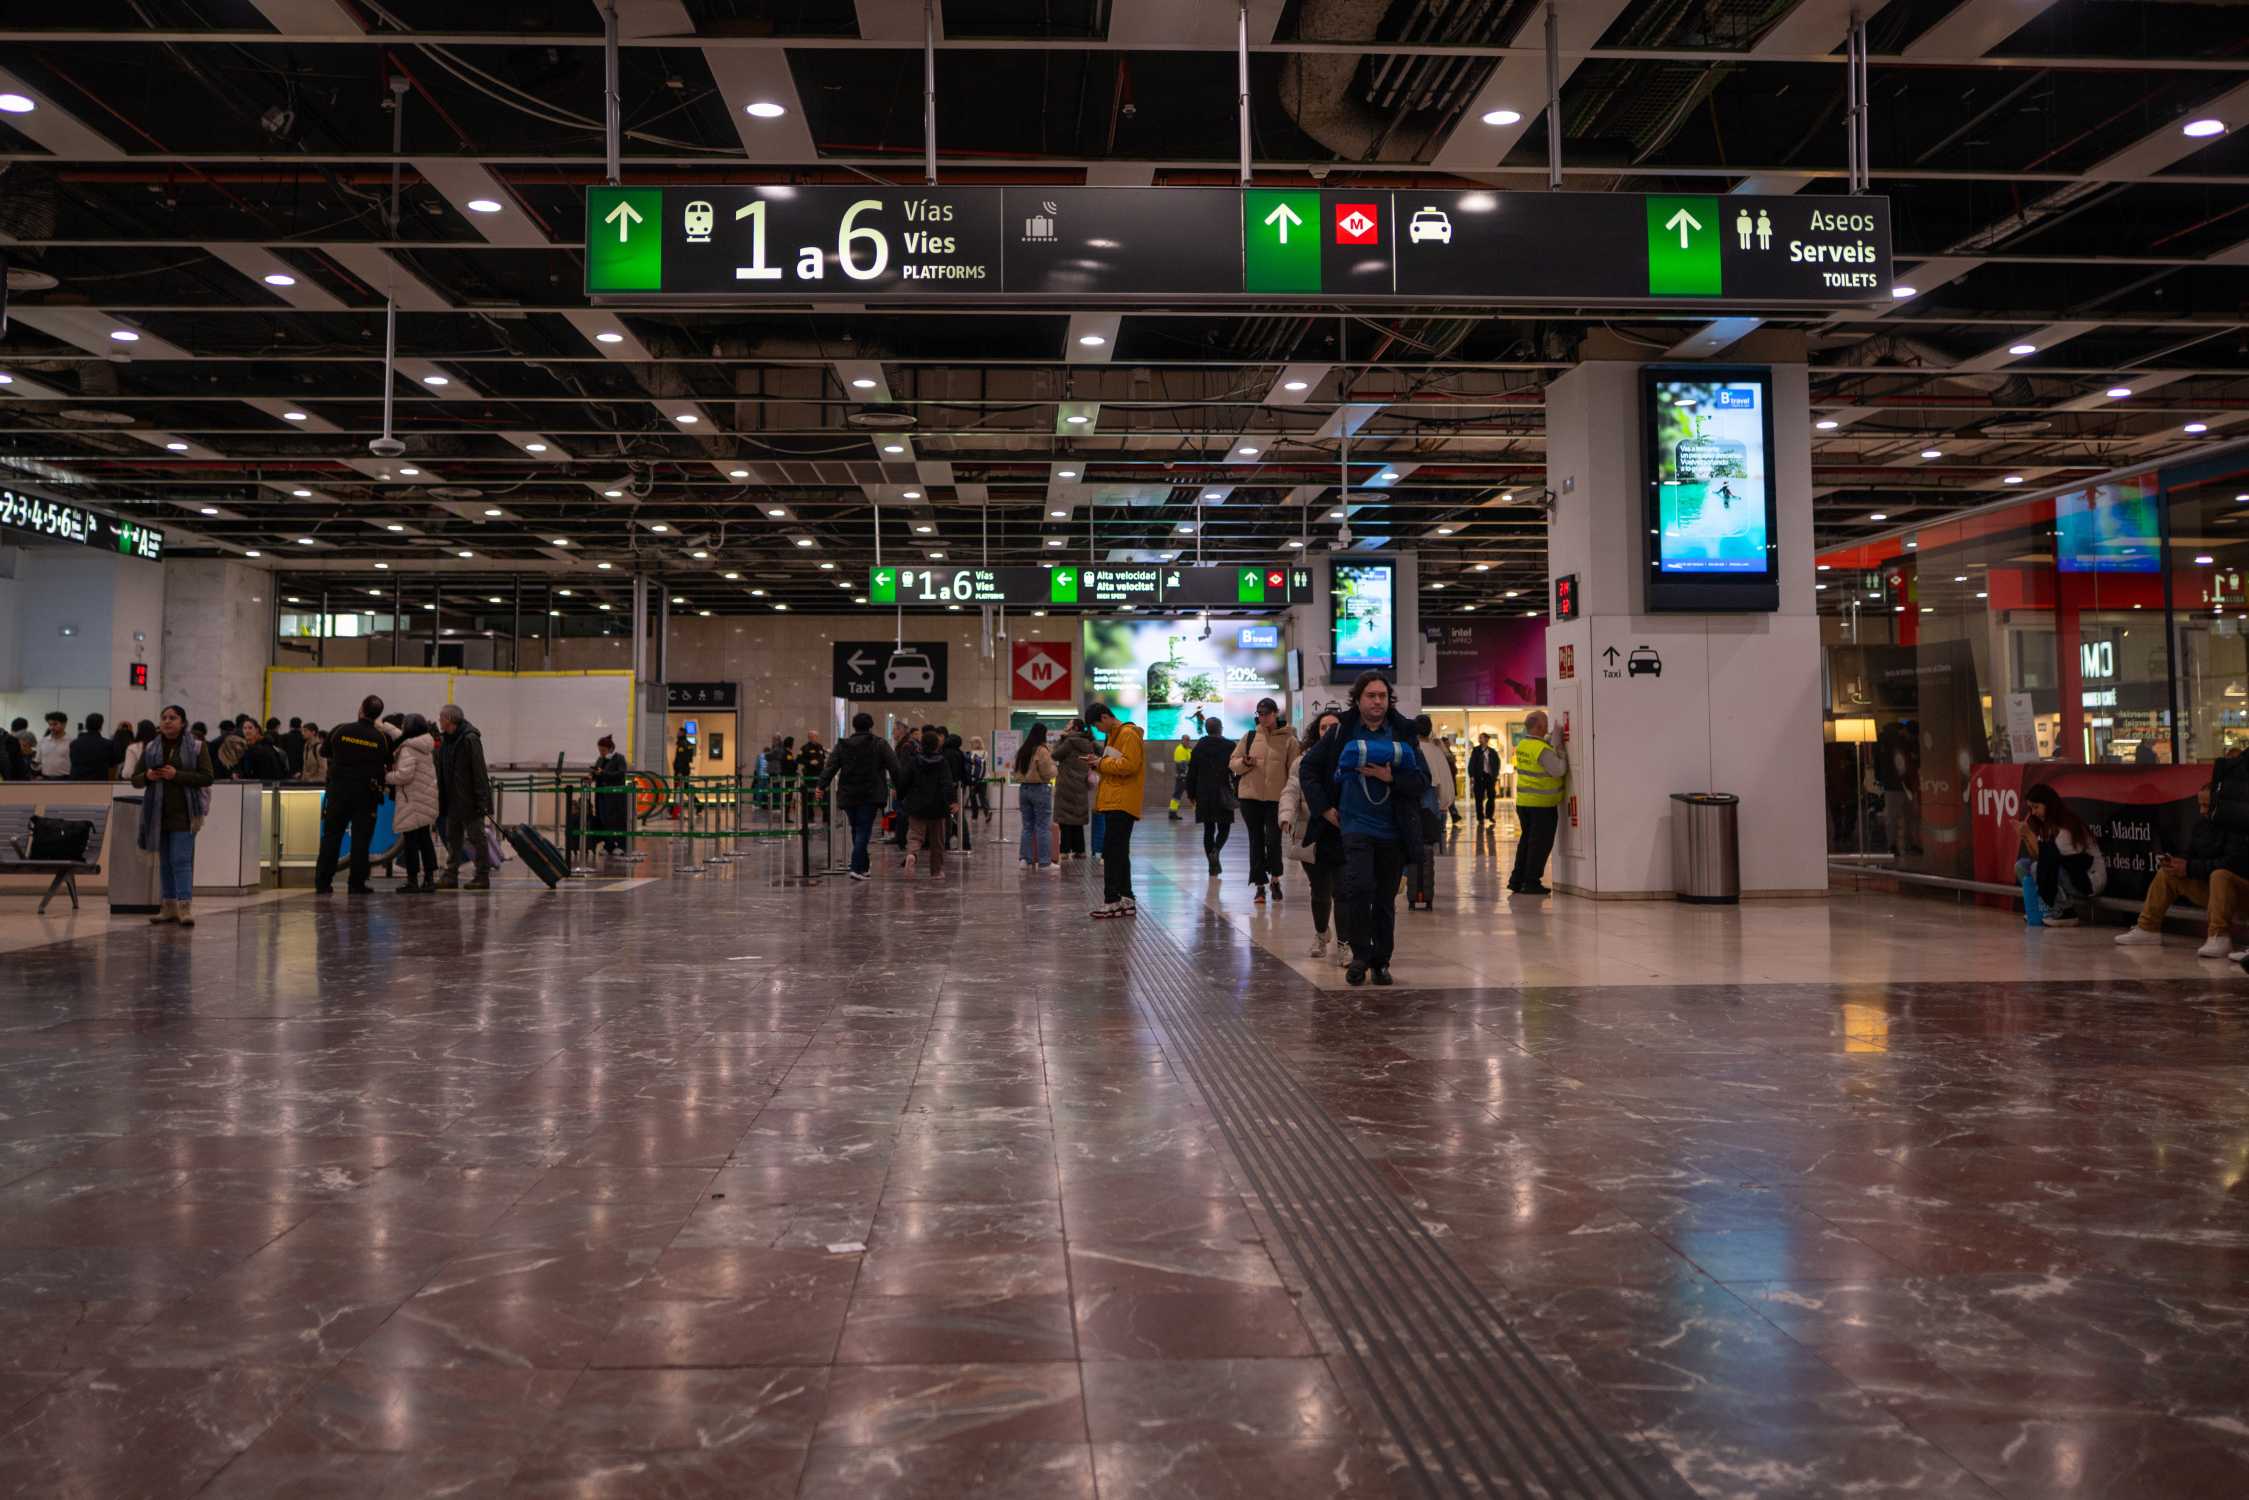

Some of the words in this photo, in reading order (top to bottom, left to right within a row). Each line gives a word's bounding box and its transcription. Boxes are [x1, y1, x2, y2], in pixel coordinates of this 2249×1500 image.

[903, 199, 953, 222] Vías
[1810, 210, 1874, 232] Aseos
[736, 200, 782, 279] 1
[796, 246, 824, 280] a
[837, 199, 889, 281] 6
[903, 230, 956, 254] Vies
[1789, 240, 1876, 263] Serveis
[903, 264, 986, 280] PLATFORMS
[1822, 272, 1877, 288] TOILETS
[138, 529, 148, 556] A
[975, 571, 994, 581] Vías
[1097, 571, 1114, 580] Alta
[1115, 571, 1156, 580] velocidad
[919, 571, 936, 599] 1
[940, 587, 950, 600] a
[953, 571, 973, 600] 6
[975, 582, 995, 591] Vies
[1097, 582, 1114, 591] Alta
[1115, 582, 1154, 591] velocitat
[1452, 627, 1472, 637] intel
[1032, 663, 1052, 681] M
[1226, 667, 1258, 681] 20%
[848, 681, 876, 694] Taxi
[1977, 777, 2019, 827] iryo
[2112, 820, 2151, 841] Madrid
[2113, 852, 2130, 870] des
[2132, 853, 2145, 871] de
